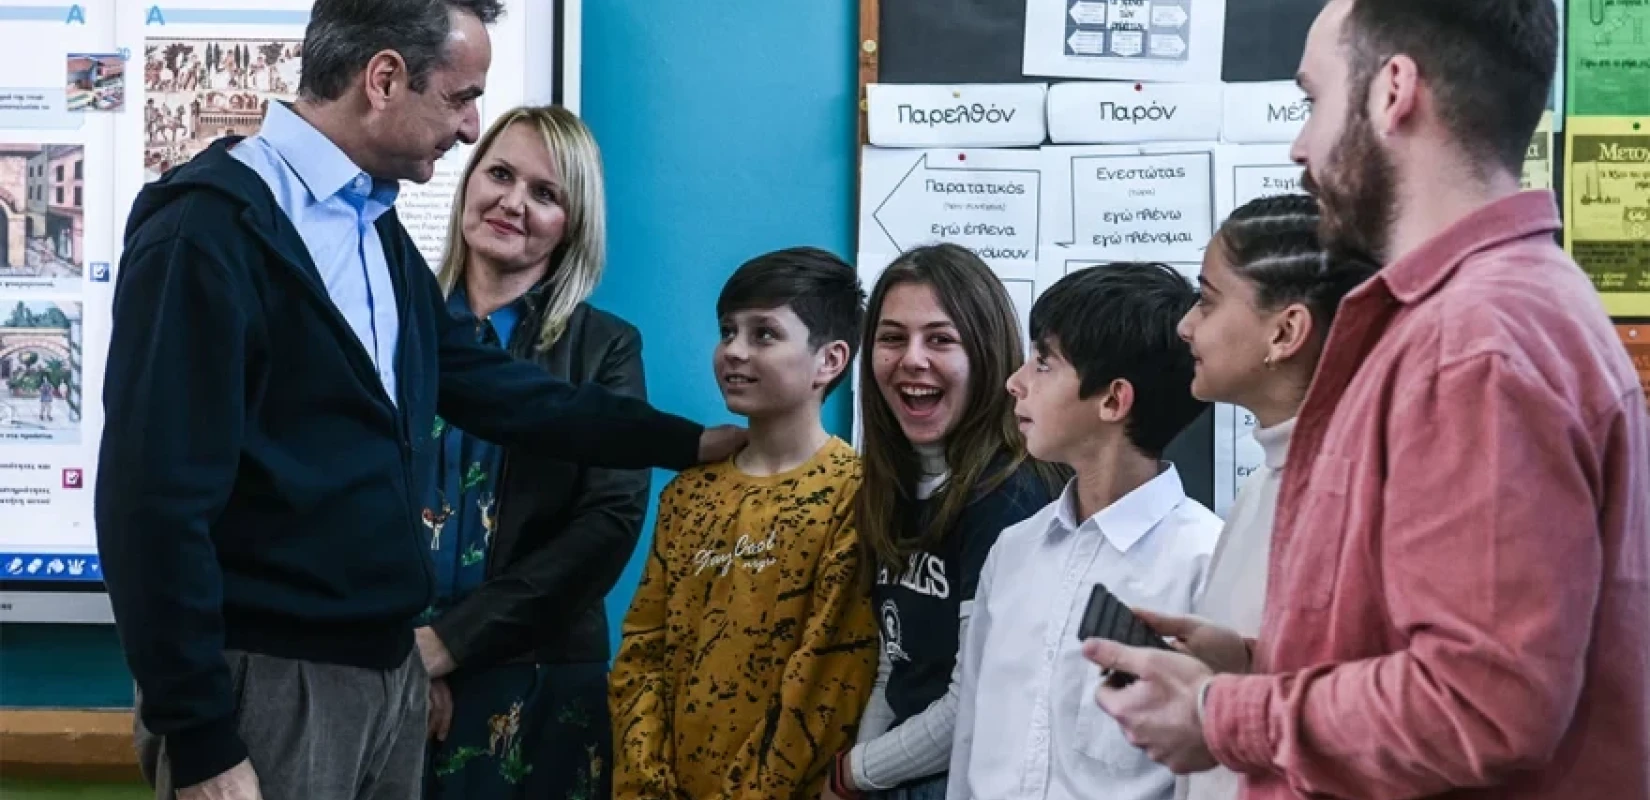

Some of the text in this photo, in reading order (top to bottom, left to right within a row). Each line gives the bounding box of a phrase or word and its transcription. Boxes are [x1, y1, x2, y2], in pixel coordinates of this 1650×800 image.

[898, 103, 1016, 128] Παρελθόν
[1100, 101, 1177, 124] Παρόν
[1267, 101, 1312, 123] Μέλ
[1096, 165, 1186, 180] Ενεστώτας
[925, 178, 1025, 196] Παρατατικός
[1103, 206, 1182, 225] εγώ πλένω
[963, 221, 1016, 236] έπλενα
[1092, 229, 1193, 247] εγώ πλένομαι
[974, 244, 1029, 259] νόμουν
